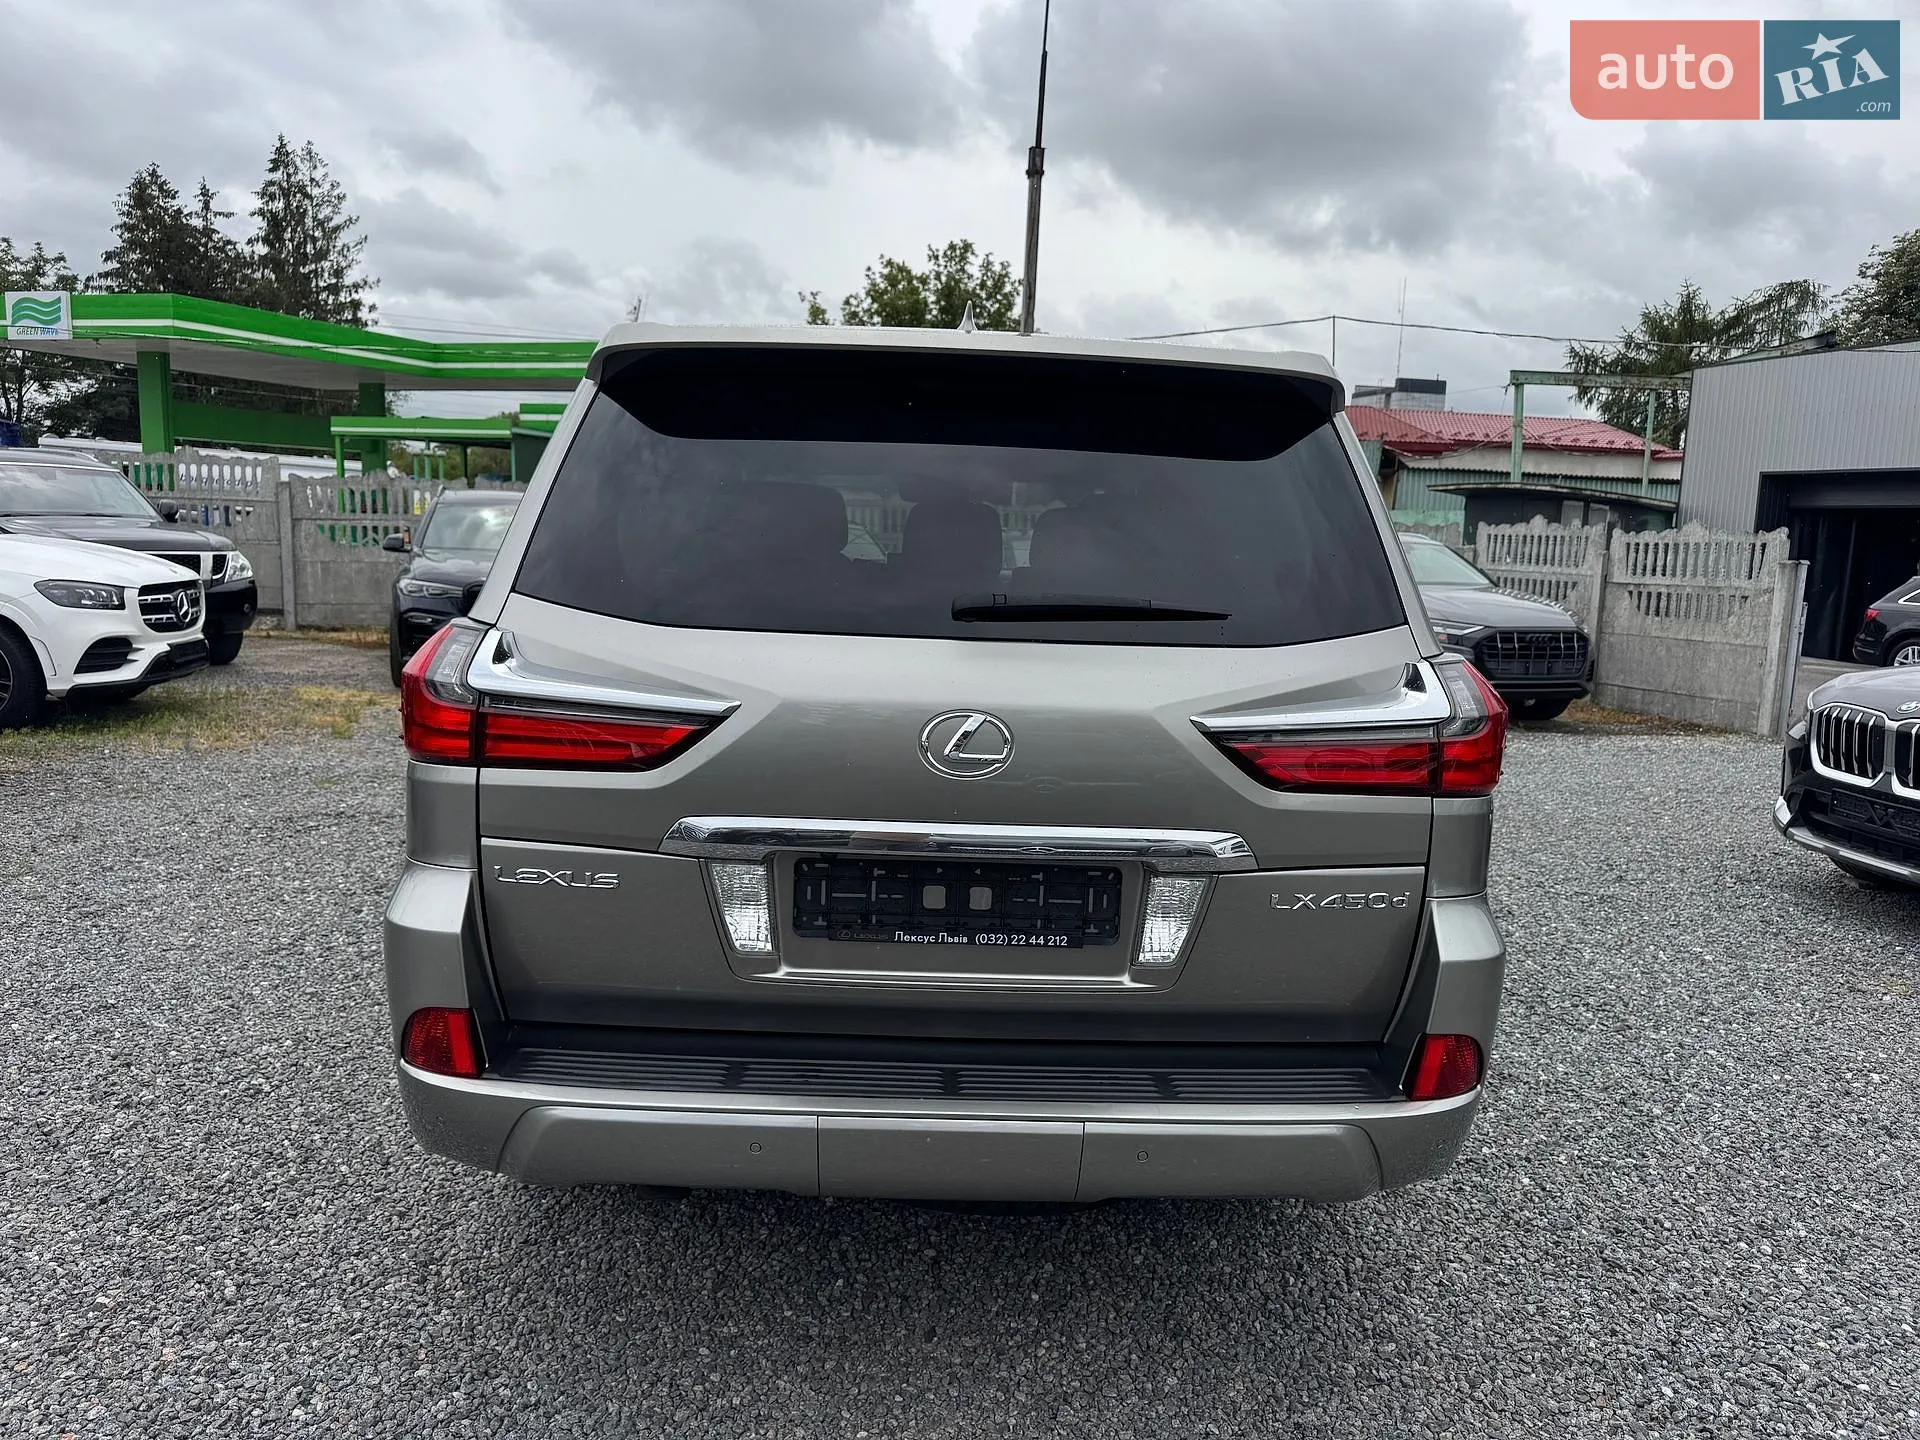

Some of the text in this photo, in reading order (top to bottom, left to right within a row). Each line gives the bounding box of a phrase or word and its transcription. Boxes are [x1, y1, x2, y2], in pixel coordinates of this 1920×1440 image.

[16, 327, 59, 336] GREEN WAVE
[493, 865, 620, 889] LEXUS
[1269, 891, 1411, 911] LX450d
[894, 931, 1068, 946] Лексус Львів (032) 22 44 212
